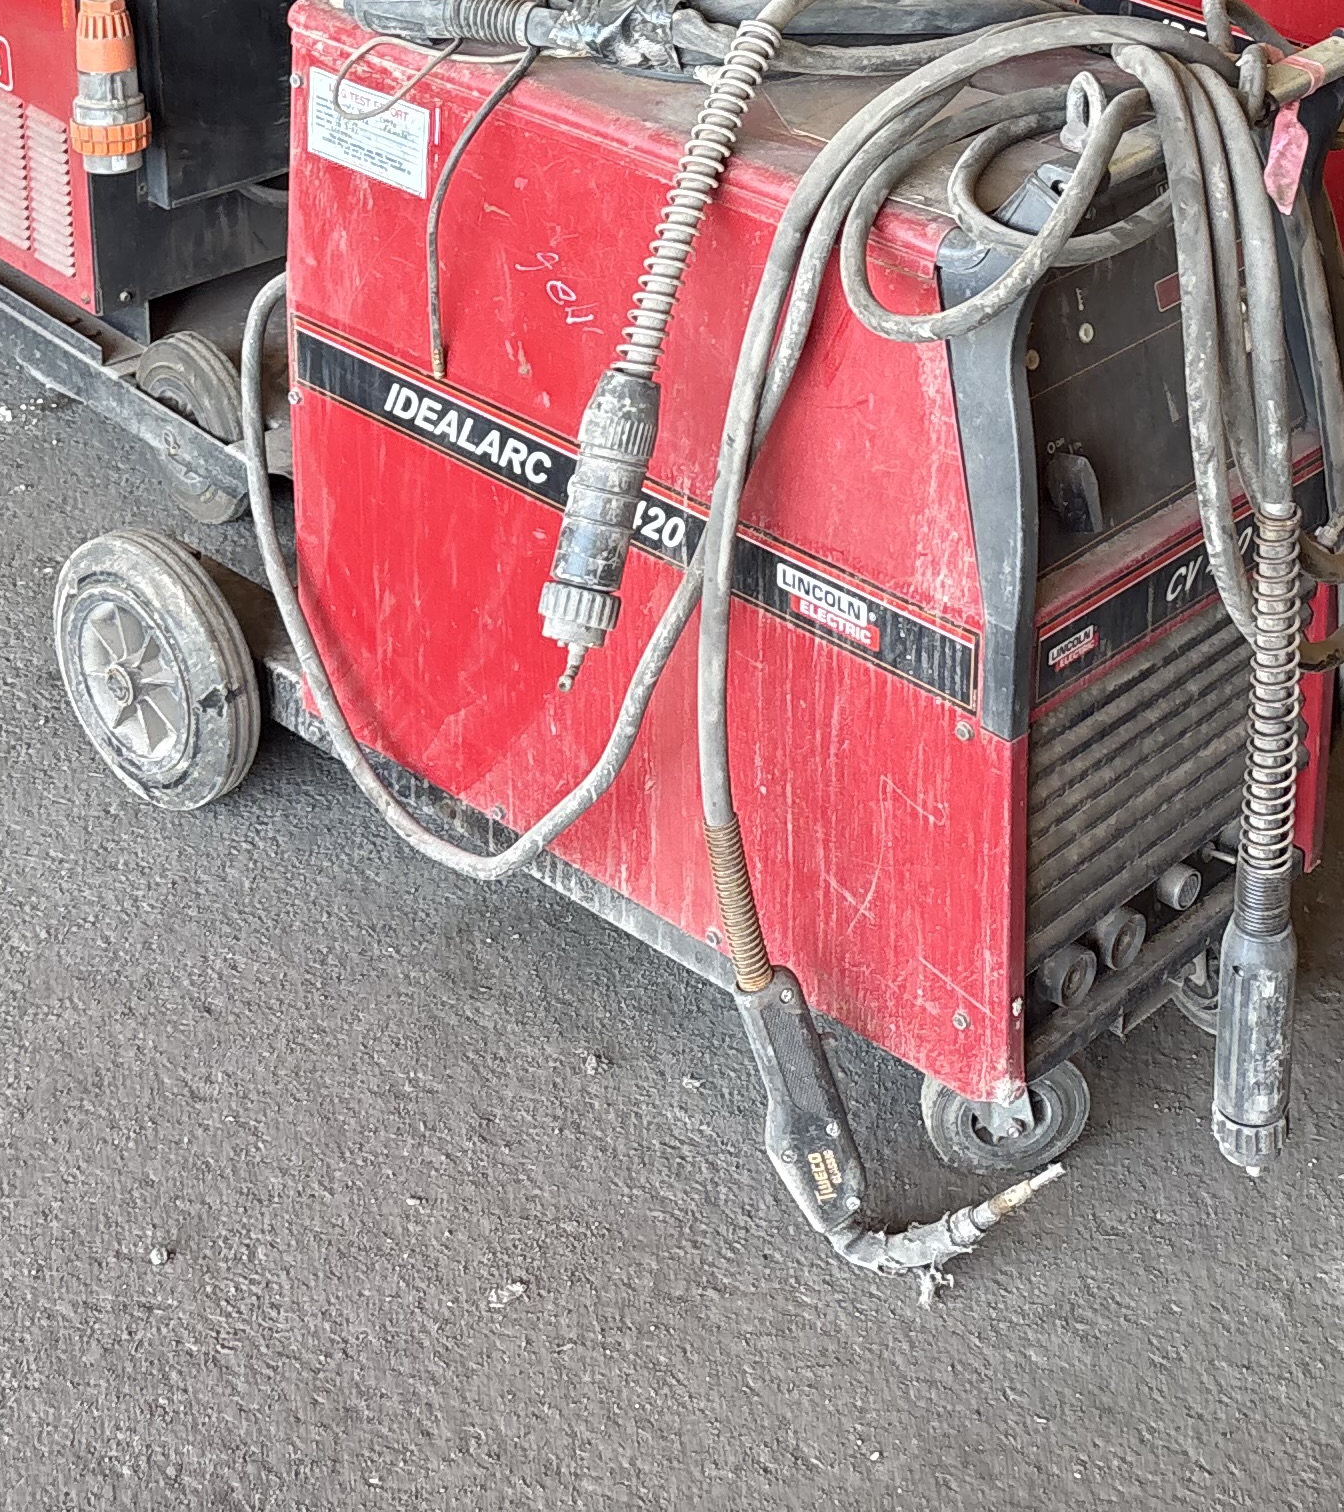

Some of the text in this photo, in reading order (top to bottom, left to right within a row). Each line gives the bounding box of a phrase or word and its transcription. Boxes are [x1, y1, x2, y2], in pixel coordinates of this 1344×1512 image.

[384, 383, 552, 484] IDEALARC
[782, 567, 861, 621] LINCOLN
[1166, 555, 1204, 602] CV
[799, 599, 872, 645] ELECTRIC
[1051, 626, 1092, 662] LINCOLN
